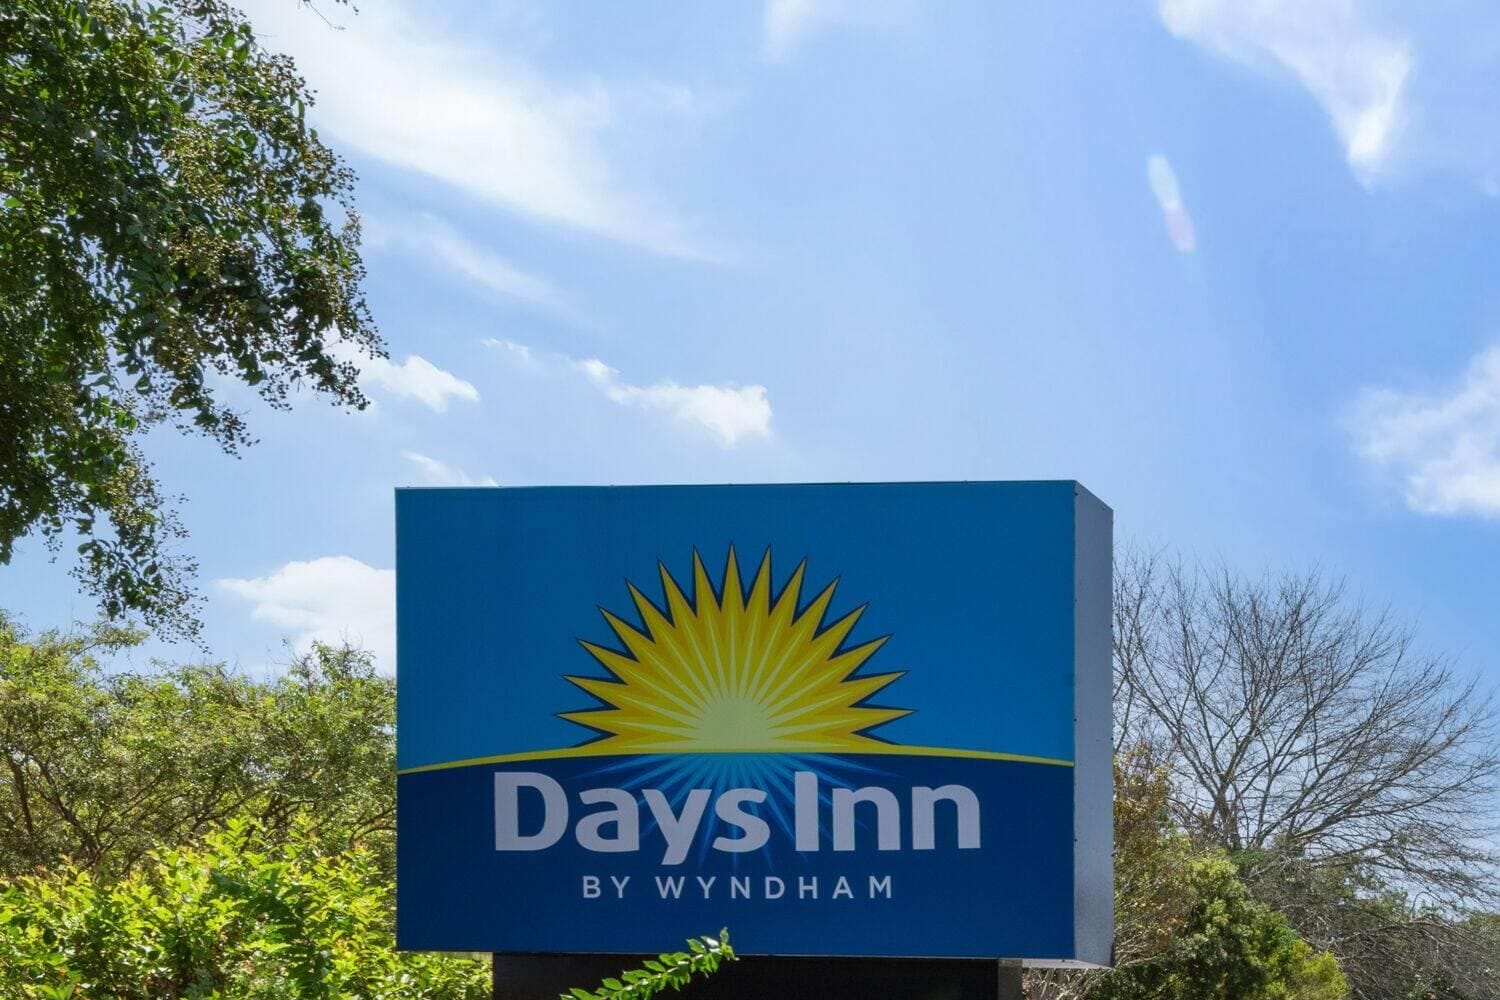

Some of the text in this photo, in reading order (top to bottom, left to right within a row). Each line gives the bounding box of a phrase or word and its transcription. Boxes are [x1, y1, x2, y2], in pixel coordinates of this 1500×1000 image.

[495, 771, 981, 865] Days Inn
[583, 876, 893, 898] BY WYNDHAM
